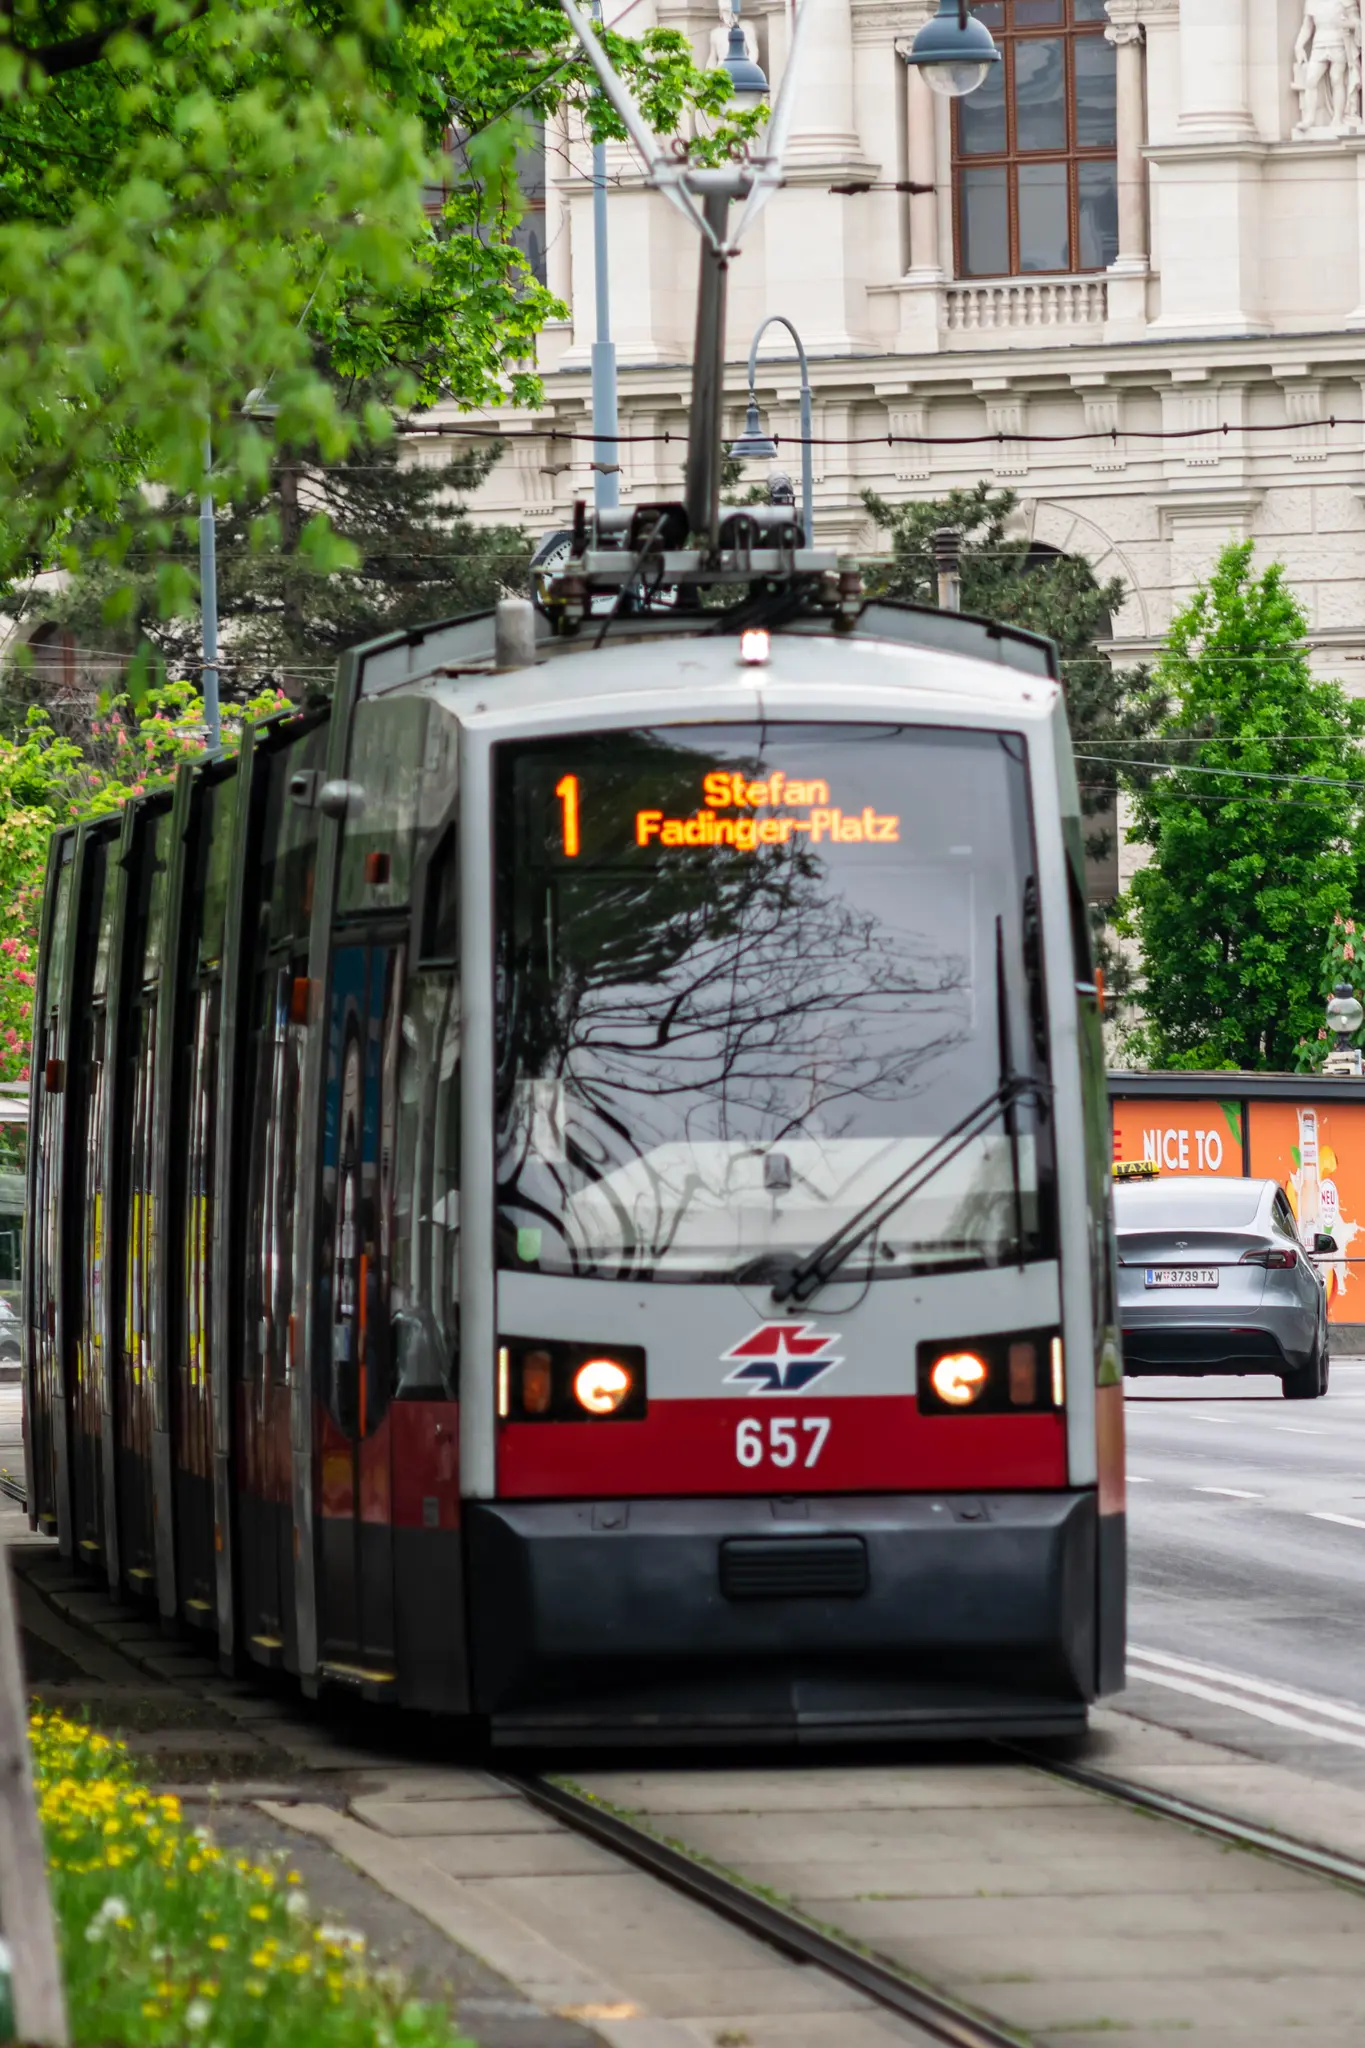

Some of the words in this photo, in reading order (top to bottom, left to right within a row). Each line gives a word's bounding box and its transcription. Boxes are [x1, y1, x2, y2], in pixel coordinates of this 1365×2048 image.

[704, 771, 829, 808] Stefan
[556, 774, 580, 857] 1
[636, 807, 899, 850] Fadinger-Platz
[1120, 1162, 1152, 1173] TAXI
[1143, 1129, 1189, 1170] NICE
[1195, 1130, 1223, 1171] TO
[1321, 1190, 1336, 1205] NEU
[1155, 1271, 1163, 1282] W
[734, 1417, 831, 1468] 657
